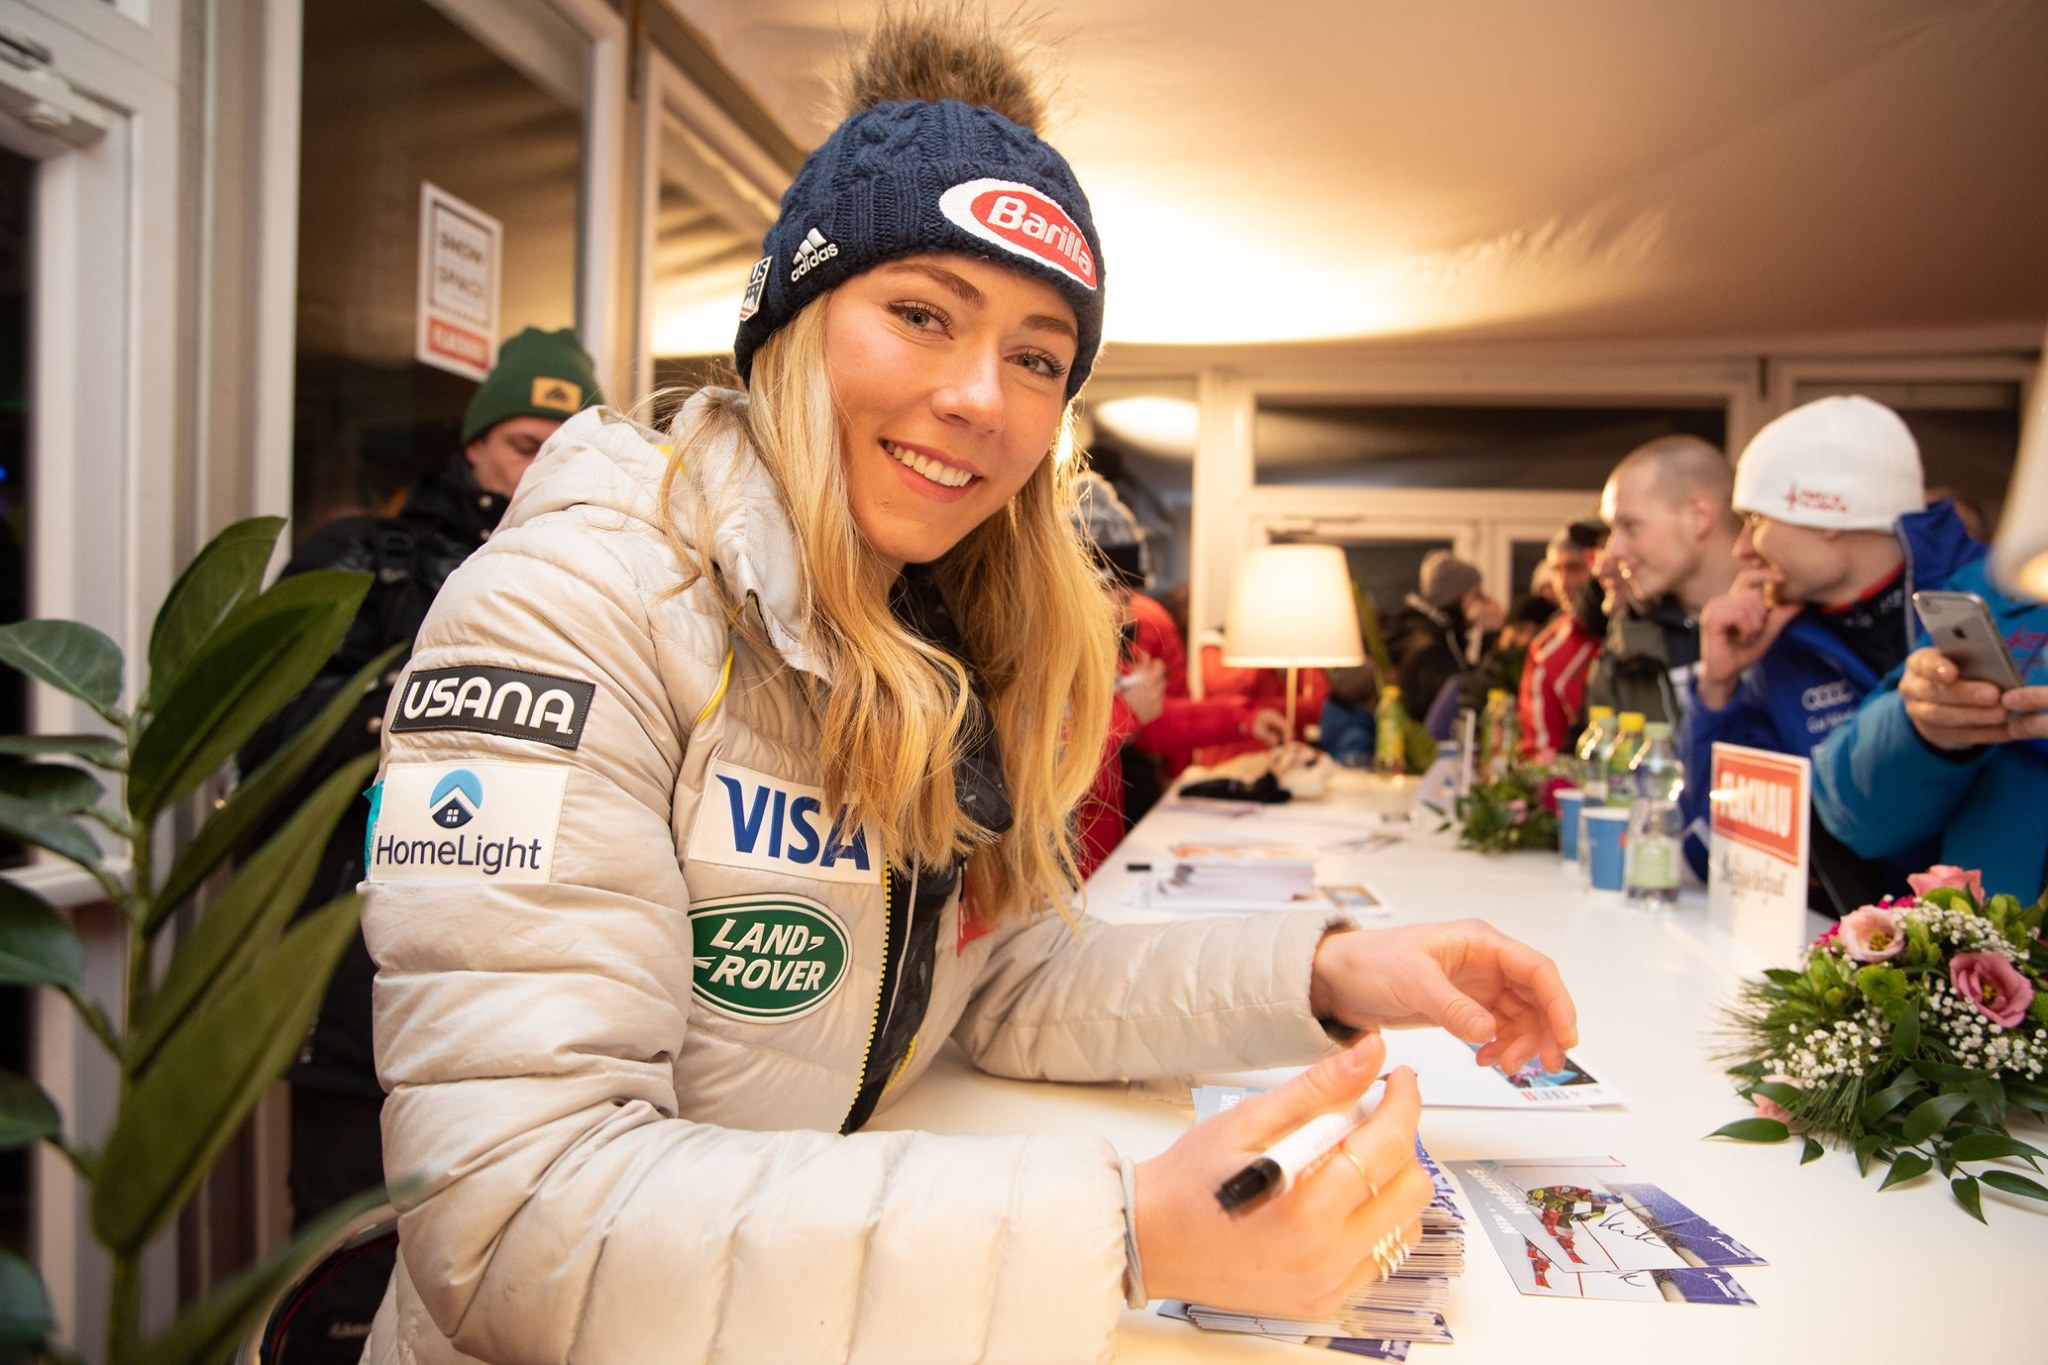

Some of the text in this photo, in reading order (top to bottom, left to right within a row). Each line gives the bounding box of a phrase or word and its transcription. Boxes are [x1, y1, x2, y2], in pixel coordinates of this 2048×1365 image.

[790, 242, 839, 283] adidas
[986, 195, 1093, 279] Barilla
[403, 675, 575, 735] USANA
[715, 773, 871, 871] VISA
[375, 834, 542, 875] HomeLight
